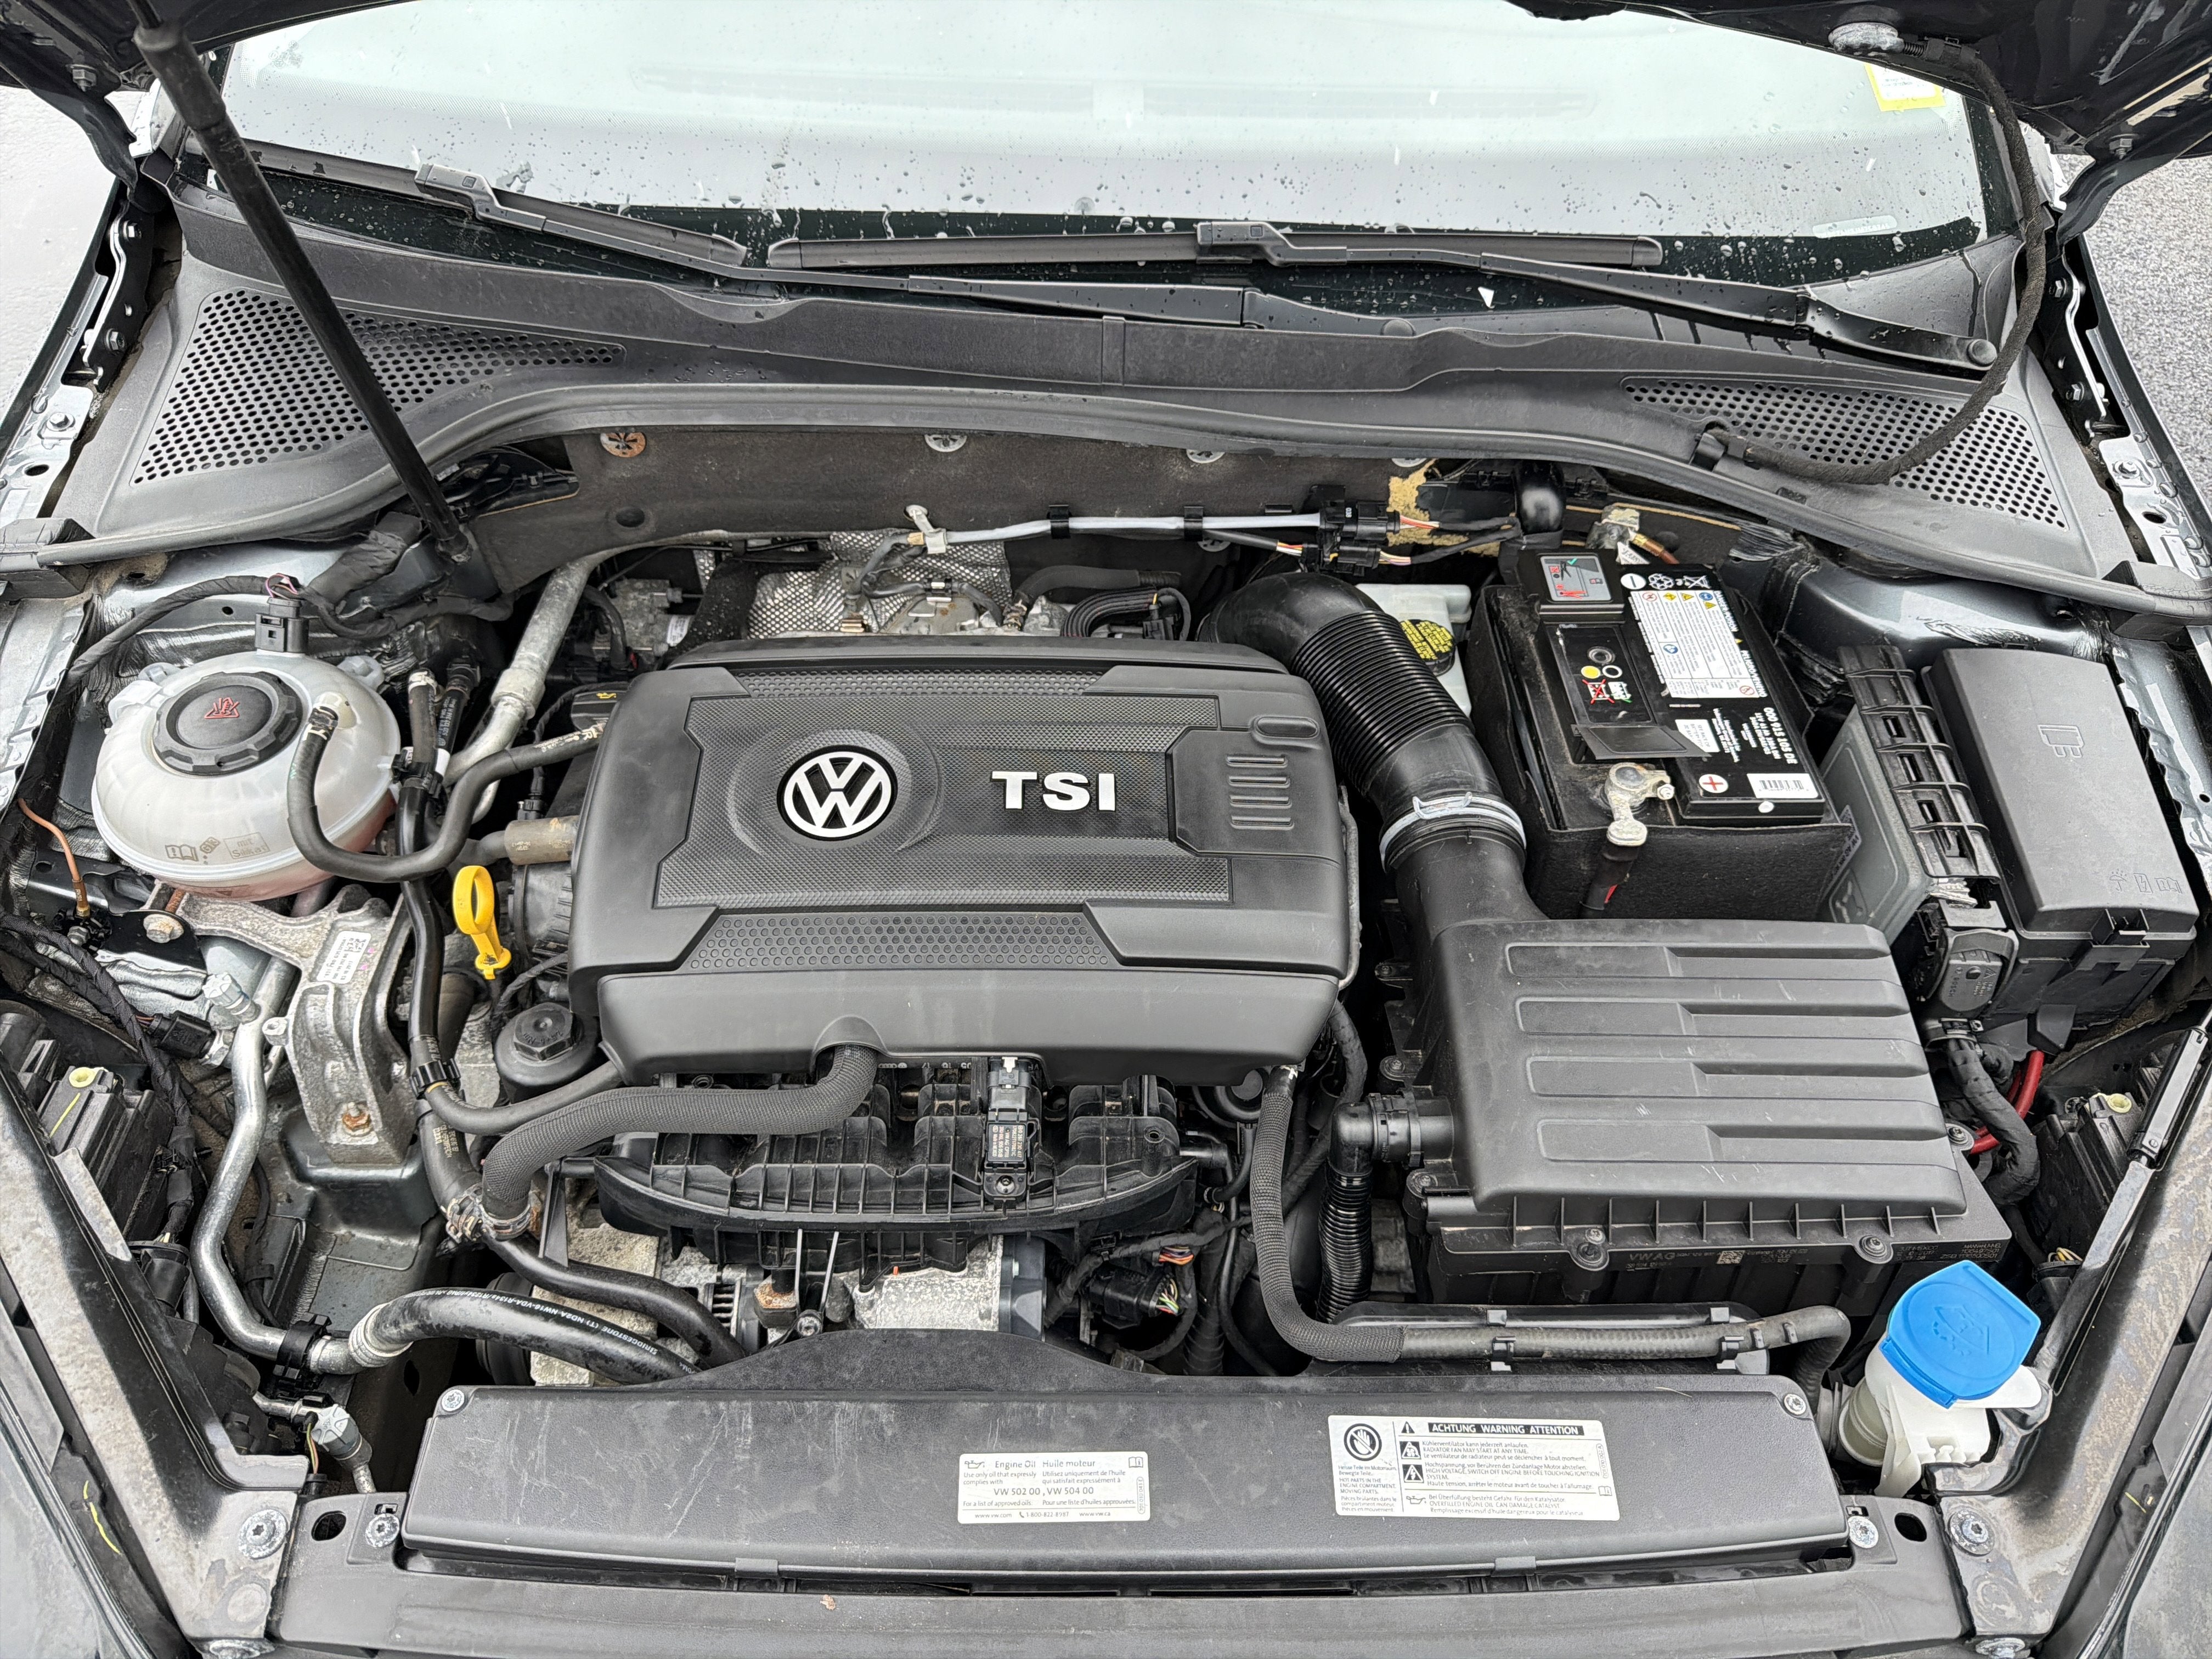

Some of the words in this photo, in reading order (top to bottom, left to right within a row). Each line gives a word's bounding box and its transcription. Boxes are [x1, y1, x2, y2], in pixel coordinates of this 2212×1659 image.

[1763, 707, 1779, 723] 000
[1770, 722, 1785, 737] 915
[1777, 737, 1792, 752] 105
[1784, 753, 1798, 765] DE
[783, 751, 892, 838] VW
[991, 770, 1117, 812] TSI
[1653, 1252, 1675, 1260] AG
[601, 1325, 658, 1356] BRIDGESTONE
[1432, 1424, 1476, 1432] ACHTUNG
[1480, 1425, 1525, 1434] WARNING
[1530, 1426, 1579, 1435] ATTENTION
[995, 1460, 1022, 1470] Engine
